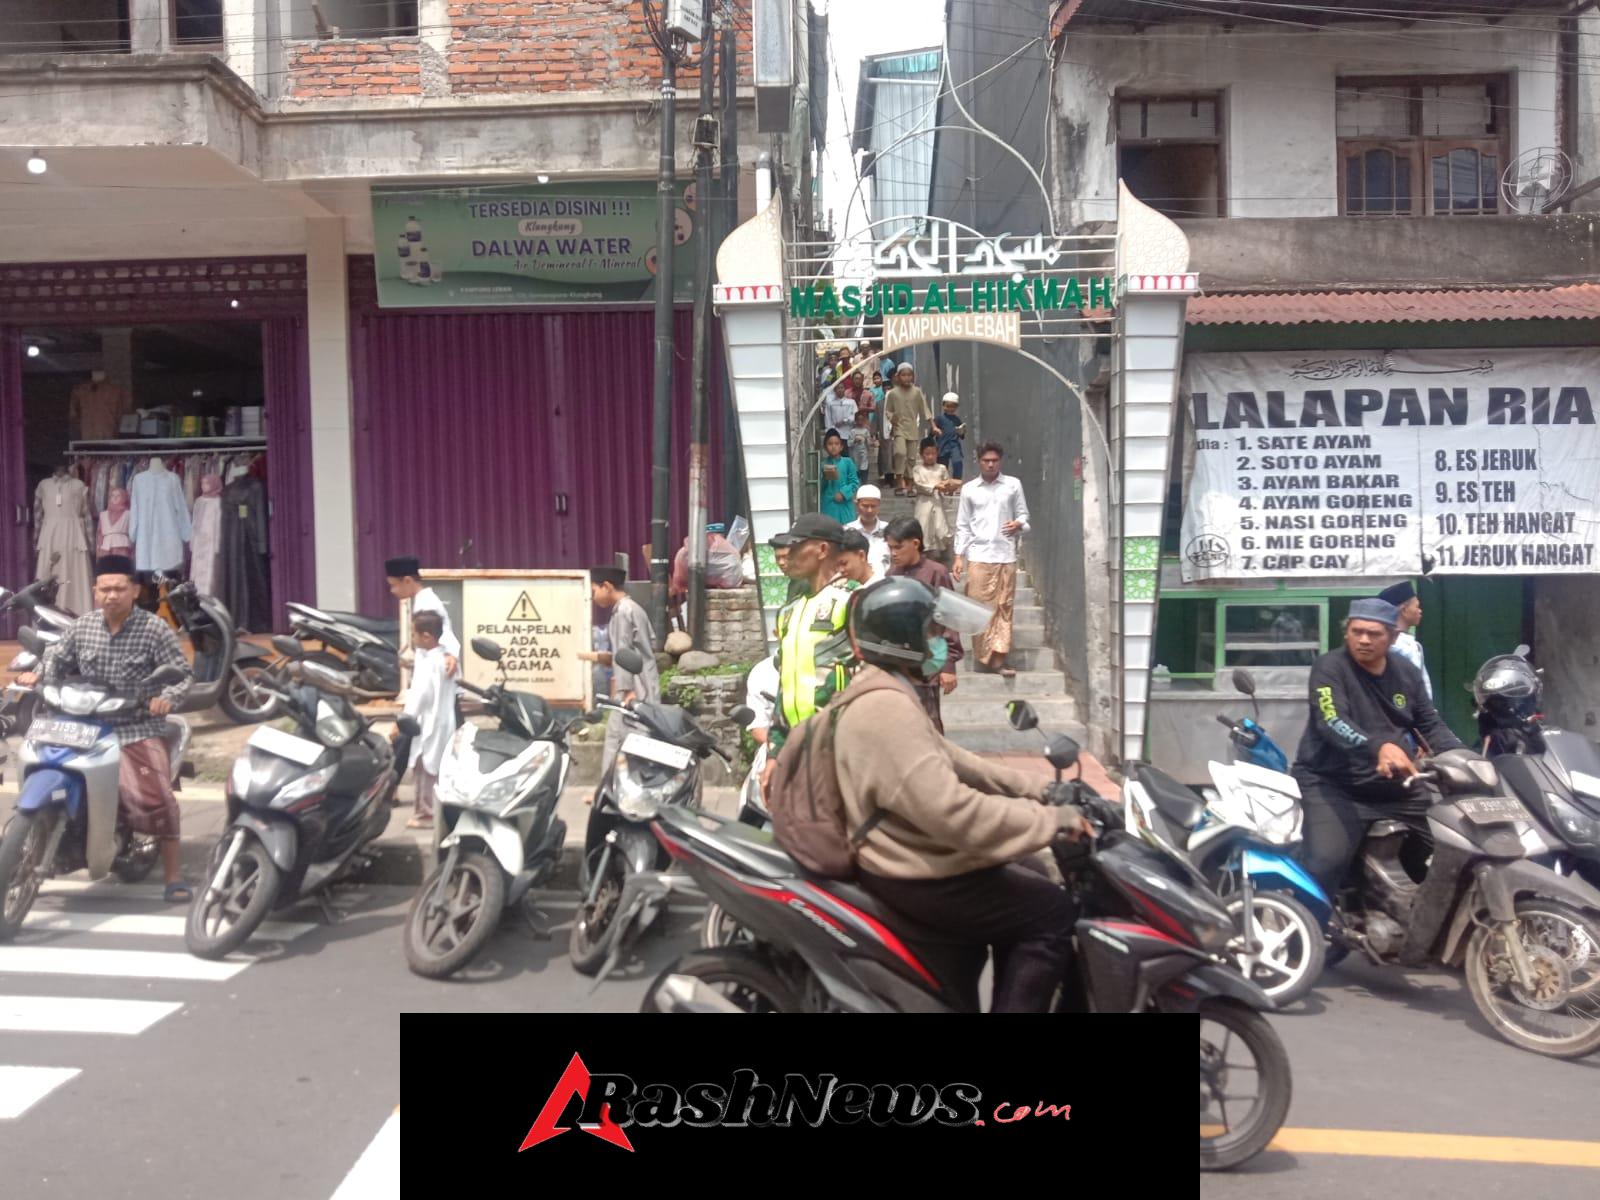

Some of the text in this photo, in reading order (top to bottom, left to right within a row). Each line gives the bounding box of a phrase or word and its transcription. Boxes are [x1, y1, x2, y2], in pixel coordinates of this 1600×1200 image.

[469, 201, 631, 218] TERSEDIA DISINI !!!
[472, 238, 631, 257] DALWA WATER
[790, 282, 912, 319] MASJID
[971, 276, 1114, 313] HIKMAH
[887, 314, 1017, 346] KAMPUNG LEBAH
[1192, 386, 1596, 430] LALAPAN RIA
[1235, 434, 1372, 450] 1. SATE AYAM
[1237, 454, 1382, 471] 2. SOTO AYAM
[1435, 448, 1537, 472] 8. ES JERUK
[1238, 474, 1400, 490] 3. AYAM BAKAR
[1435, 481, 1516, 503] 9. ES TEH
[1239, 493, 1413, 510] 4. AYAM GORENG
[1240, 514, 1408, 530] 5. NASI GORENG
[1436, 511, 1576, 535] 10. TEH HANGAT
[1241, 534, 1396, 550] 6. MIE GORENG
[1241, 554, 1349, 570] 7. CAP CAY
[1436, 543, 1594, 566] 11. JERUK HANGAT
[477, 624, 571, 635] PELAN-PELAN
[510, 637, 538, 646] ADA
[500, 648, 560, 659] PACARA
[496, 661, 552, 671] AGAMA
